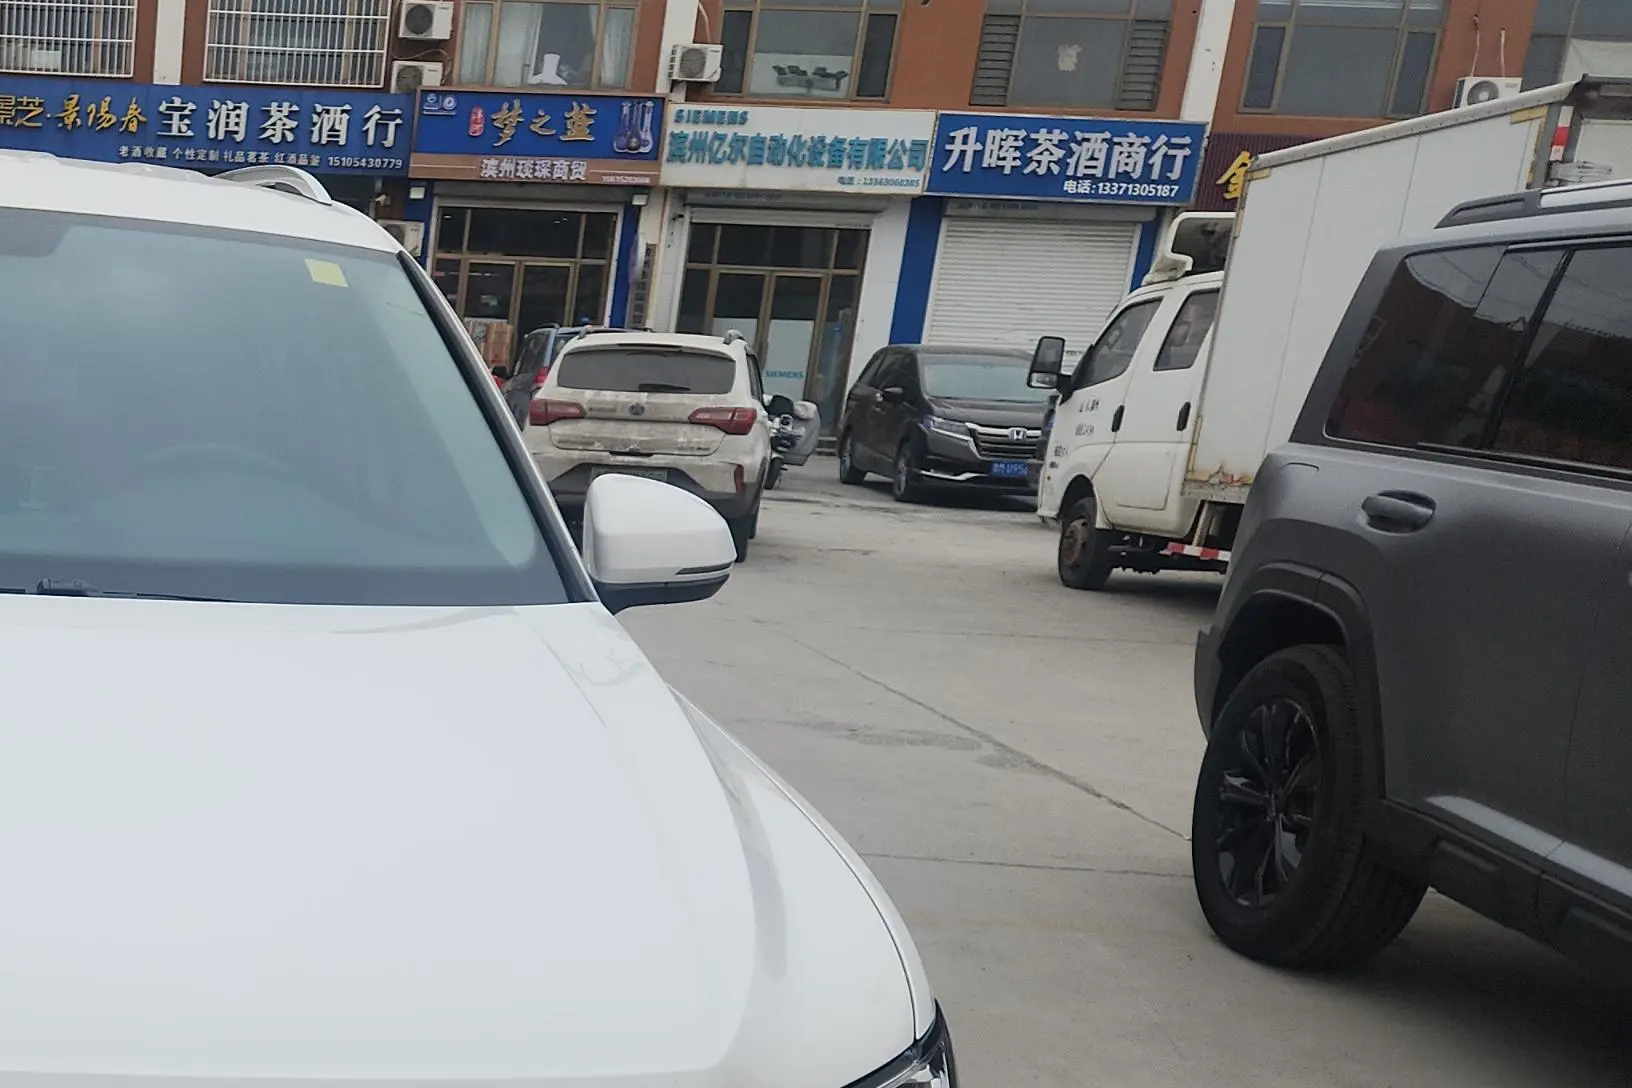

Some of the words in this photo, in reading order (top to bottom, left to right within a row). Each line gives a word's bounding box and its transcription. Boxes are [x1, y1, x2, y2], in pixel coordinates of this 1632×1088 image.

[156, 96, 404, 146] 宝润茶酒行
[673, 108, 749, 126] SIEMENS
[328, 155, 403, 170] 15105430779
[666, 130, 931, 173] 滨州亿尔自动化设备有限公司
[942, 125, 1193, 181] 升晖茶酒商行
